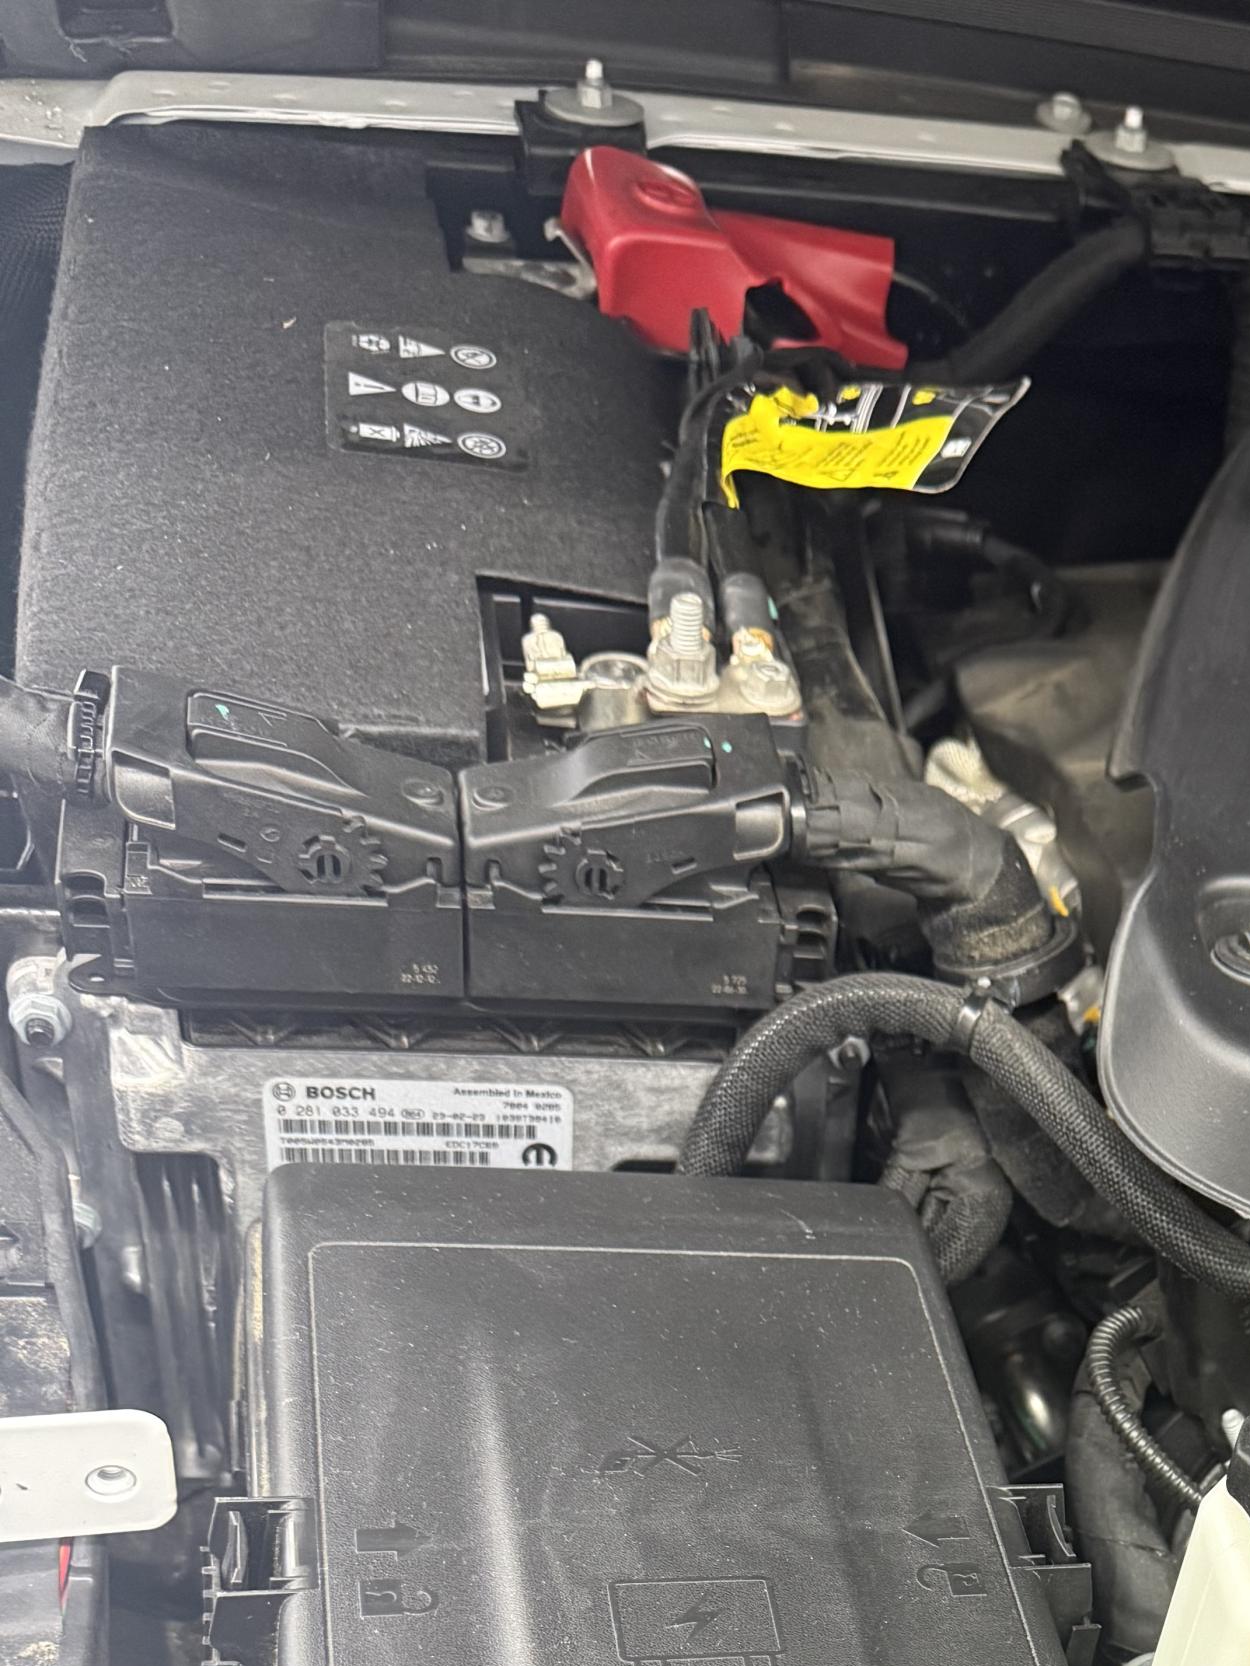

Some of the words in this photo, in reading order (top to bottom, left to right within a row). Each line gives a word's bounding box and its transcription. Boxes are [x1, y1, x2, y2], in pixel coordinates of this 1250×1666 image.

[305, 1086, 376, 1101] BOSCH
[454, 1087, 511, 1099] Assembled
[525, 1089, 563, 1100] Mexico
[295, 1104, 321, 1117] 281
[331, 1105, 360, 1118] 033
[368, 1107, 396, 1119] 494
